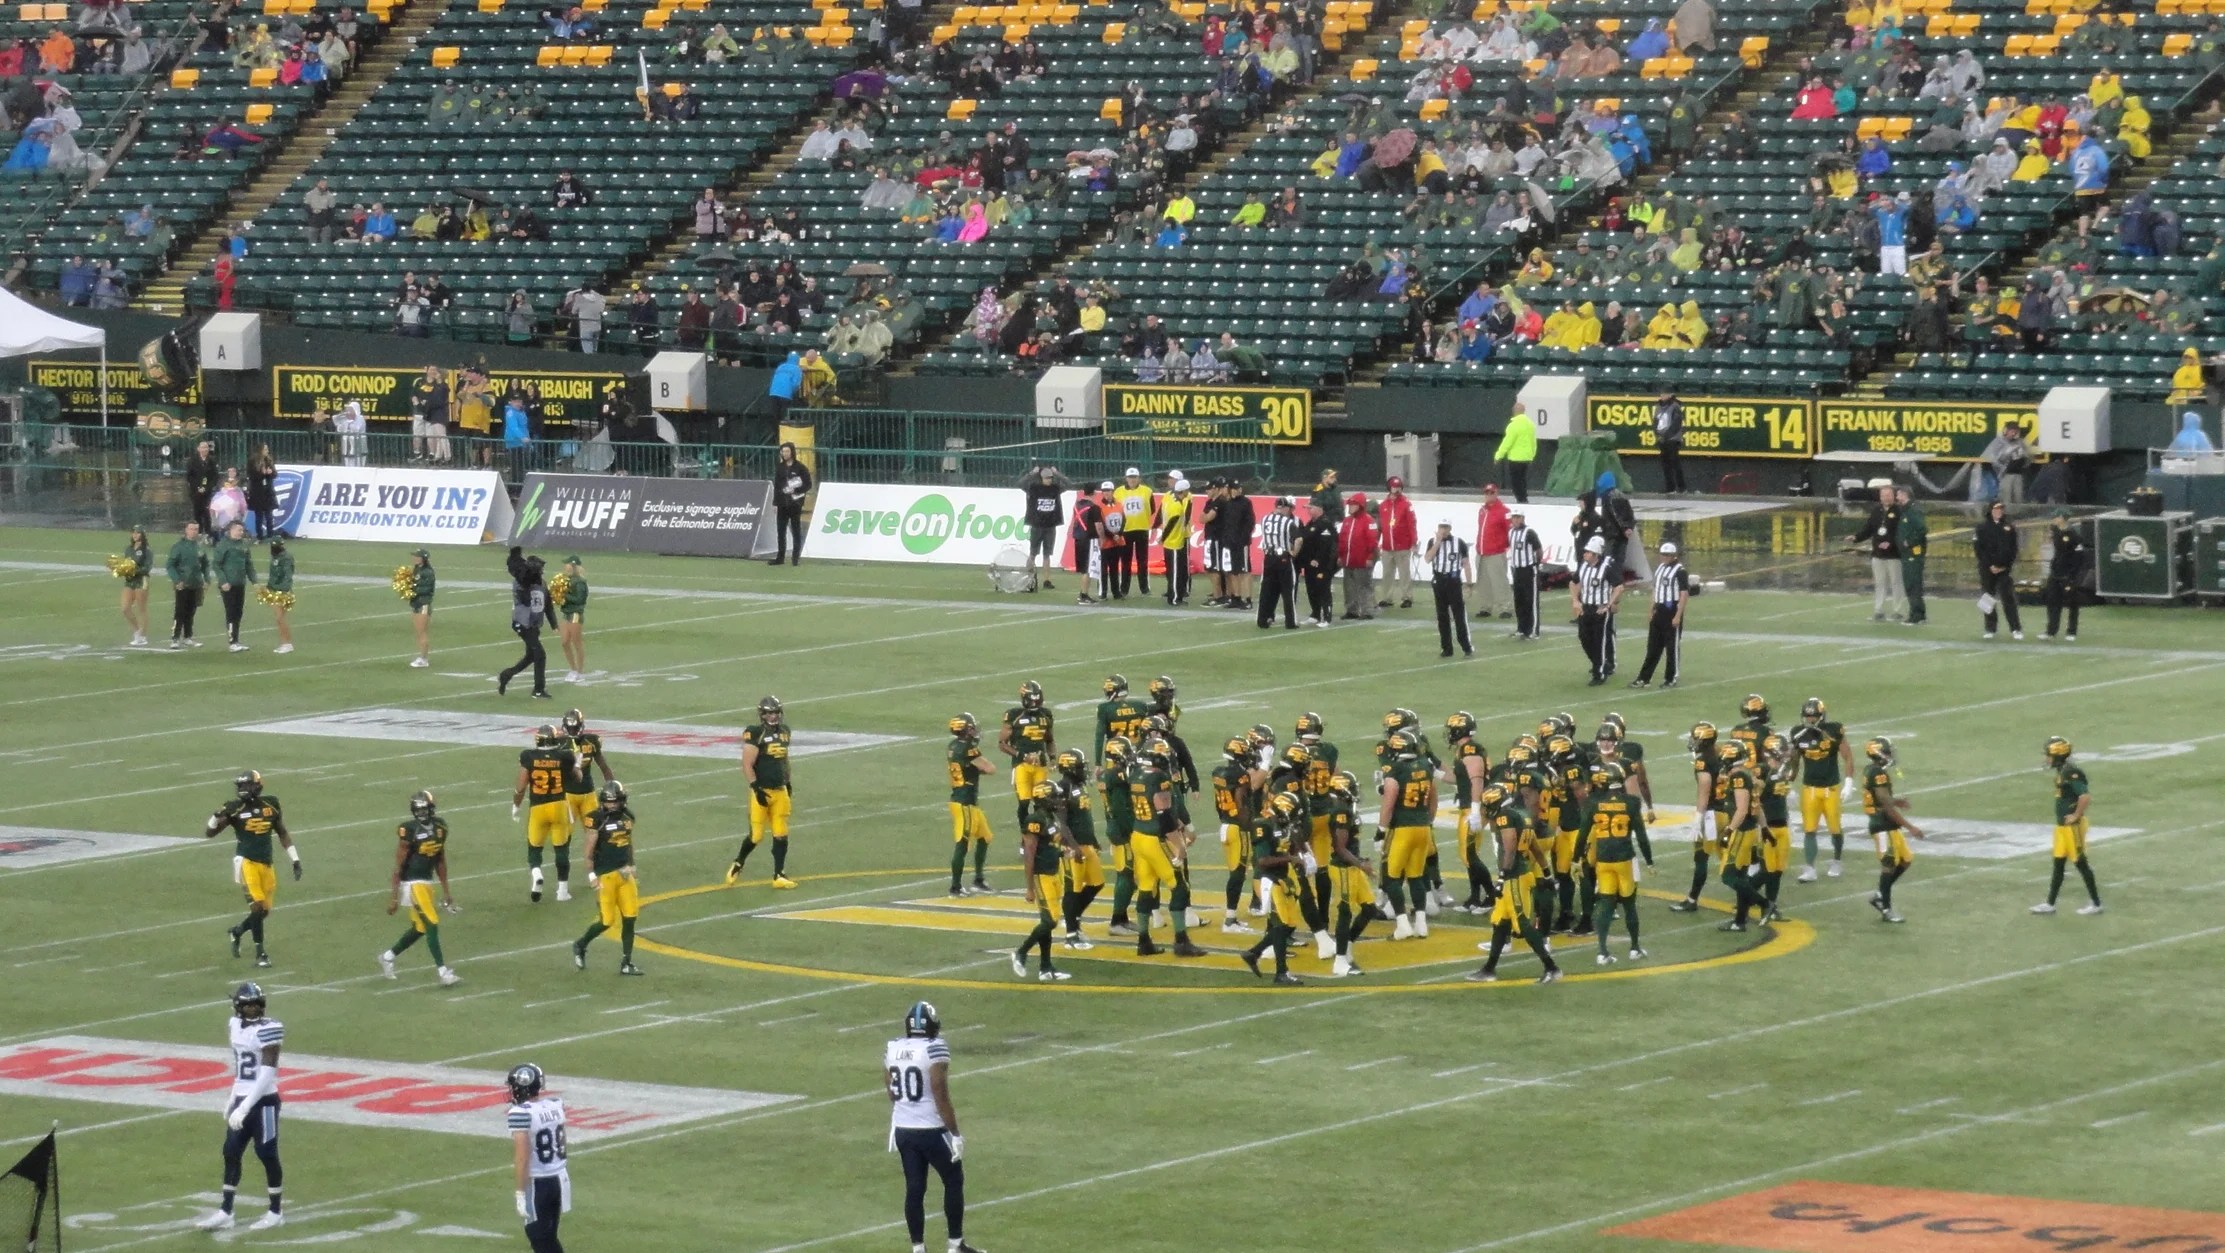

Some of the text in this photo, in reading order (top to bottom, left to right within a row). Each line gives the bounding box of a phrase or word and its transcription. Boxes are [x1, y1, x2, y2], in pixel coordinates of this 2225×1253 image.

[217, 344, 227, 360] A
[37, 368, 152, 390] HECTOR POTHI
[291, 374, 397, 395] ROD CONNOP
[661, 382, 670, 398] B
[1054, 396, 1064, 414] C
[1122, 393, 1245, 416] DANNY BASS
[1260, 397, 1303, 437] 30
[1537, 408, 1548, 426] D
[1826, 410, 1988, 434] FRANK MORRIS
[1763, 407, 1806, 449] 14
[2061, 421, 2071, 439] E
[1867, 435, 1953, 452] 1950-1958
[314, 482, 487, 511] ARE YOU IN?
[556, 487, 632, 501] WILLIAM
[546, 500, 630, 530] HUFF
[642, 500, 760, 518] Exclusive signage supplier
[1125, 501, 1142, 511] CFL
[309, 510, 480, 530] FCEDMONTON.CLUB
[641, 518, 753, 531] of the Edmonton Eskimos
[821, 508, 901, 537] save
[904, 512, 950, 538] on
[1264, 521, 1279, 535] 31
